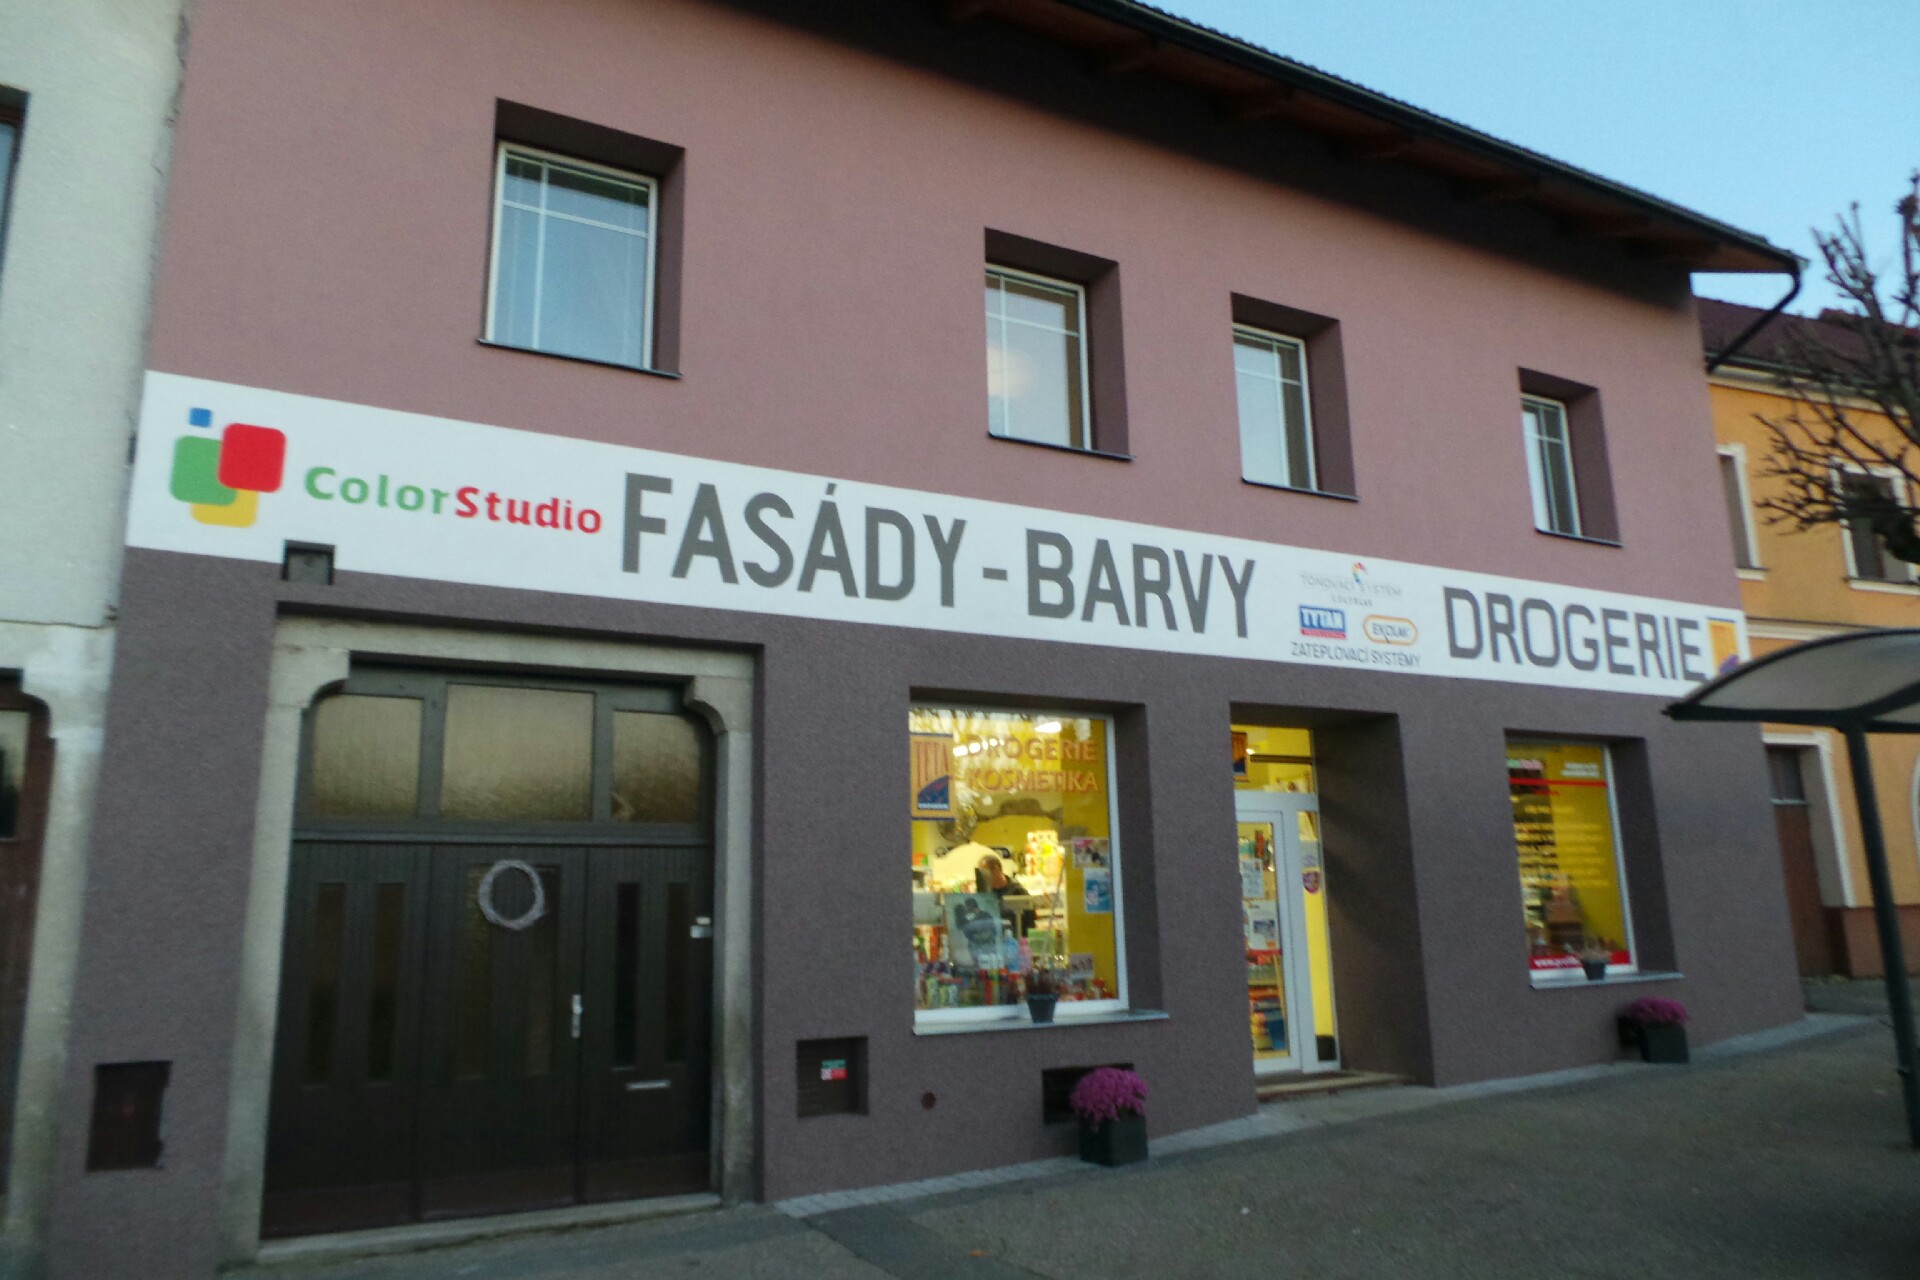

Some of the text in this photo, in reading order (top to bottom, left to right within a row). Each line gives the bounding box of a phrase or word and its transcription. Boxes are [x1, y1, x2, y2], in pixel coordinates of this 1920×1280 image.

[304, 466, 602, 534] ColorStudio
[622, 472, 967, 608] FASÁDY
[1026, 527, 1256, 639] BARVY
[1443, 586, 1706, 683] DROGERIE
[966, 767, 1100, 794] KOSMETIKA
